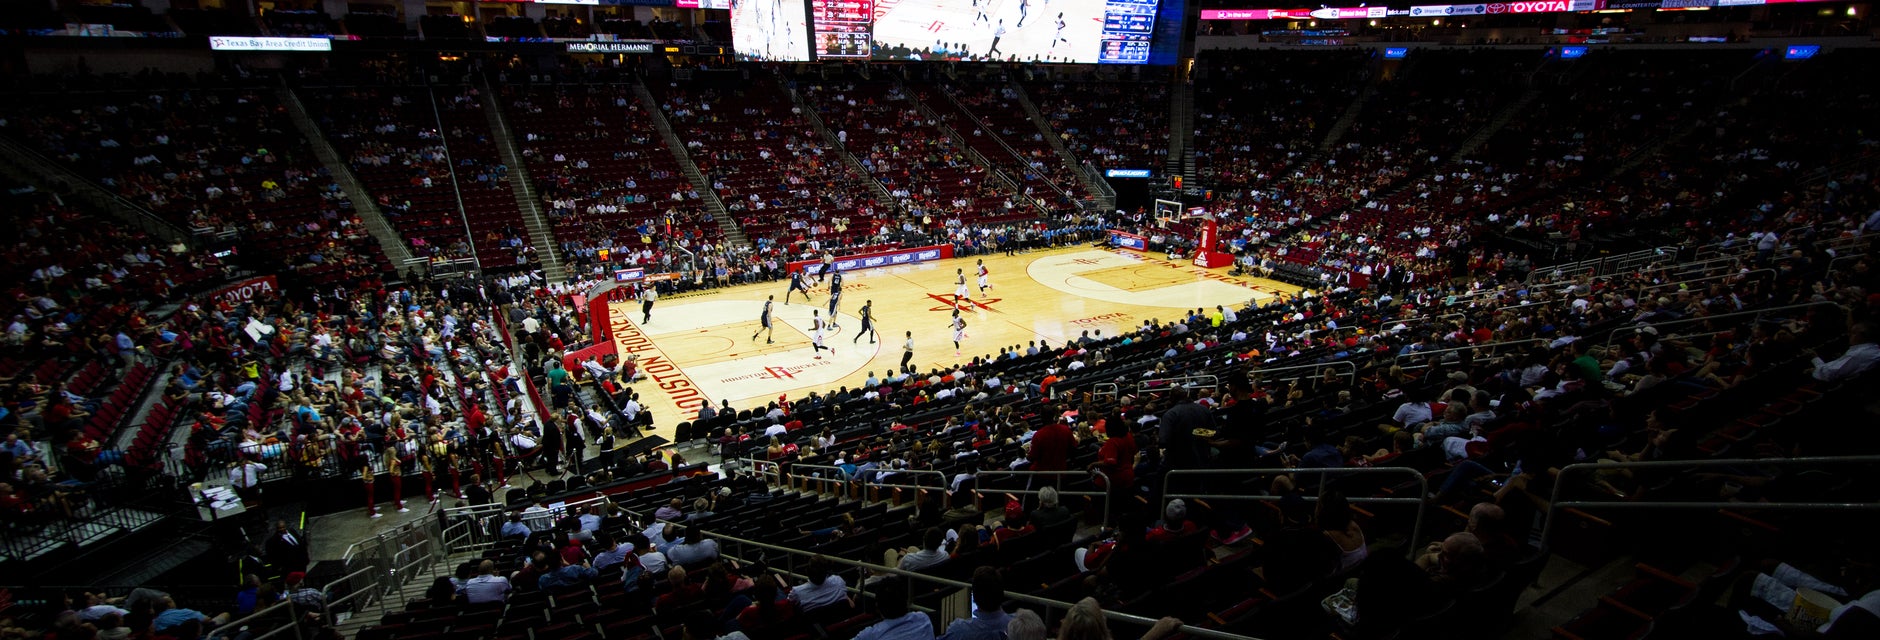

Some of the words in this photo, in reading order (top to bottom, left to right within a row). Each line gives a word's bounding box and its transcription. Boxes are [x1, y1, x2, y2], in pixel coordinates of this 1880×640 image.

[1506, 1, 1567, 13] TOYOTA
[226, 39, 248, 47] Texas
[249, 39, 263, 49] Bay
[265, 40, 282, 48] Area
[284, 40, 306, 48] Credit
[569, 43, 609, 51] MEMORIAL
[214, 280, 273, 302] OYOTA
